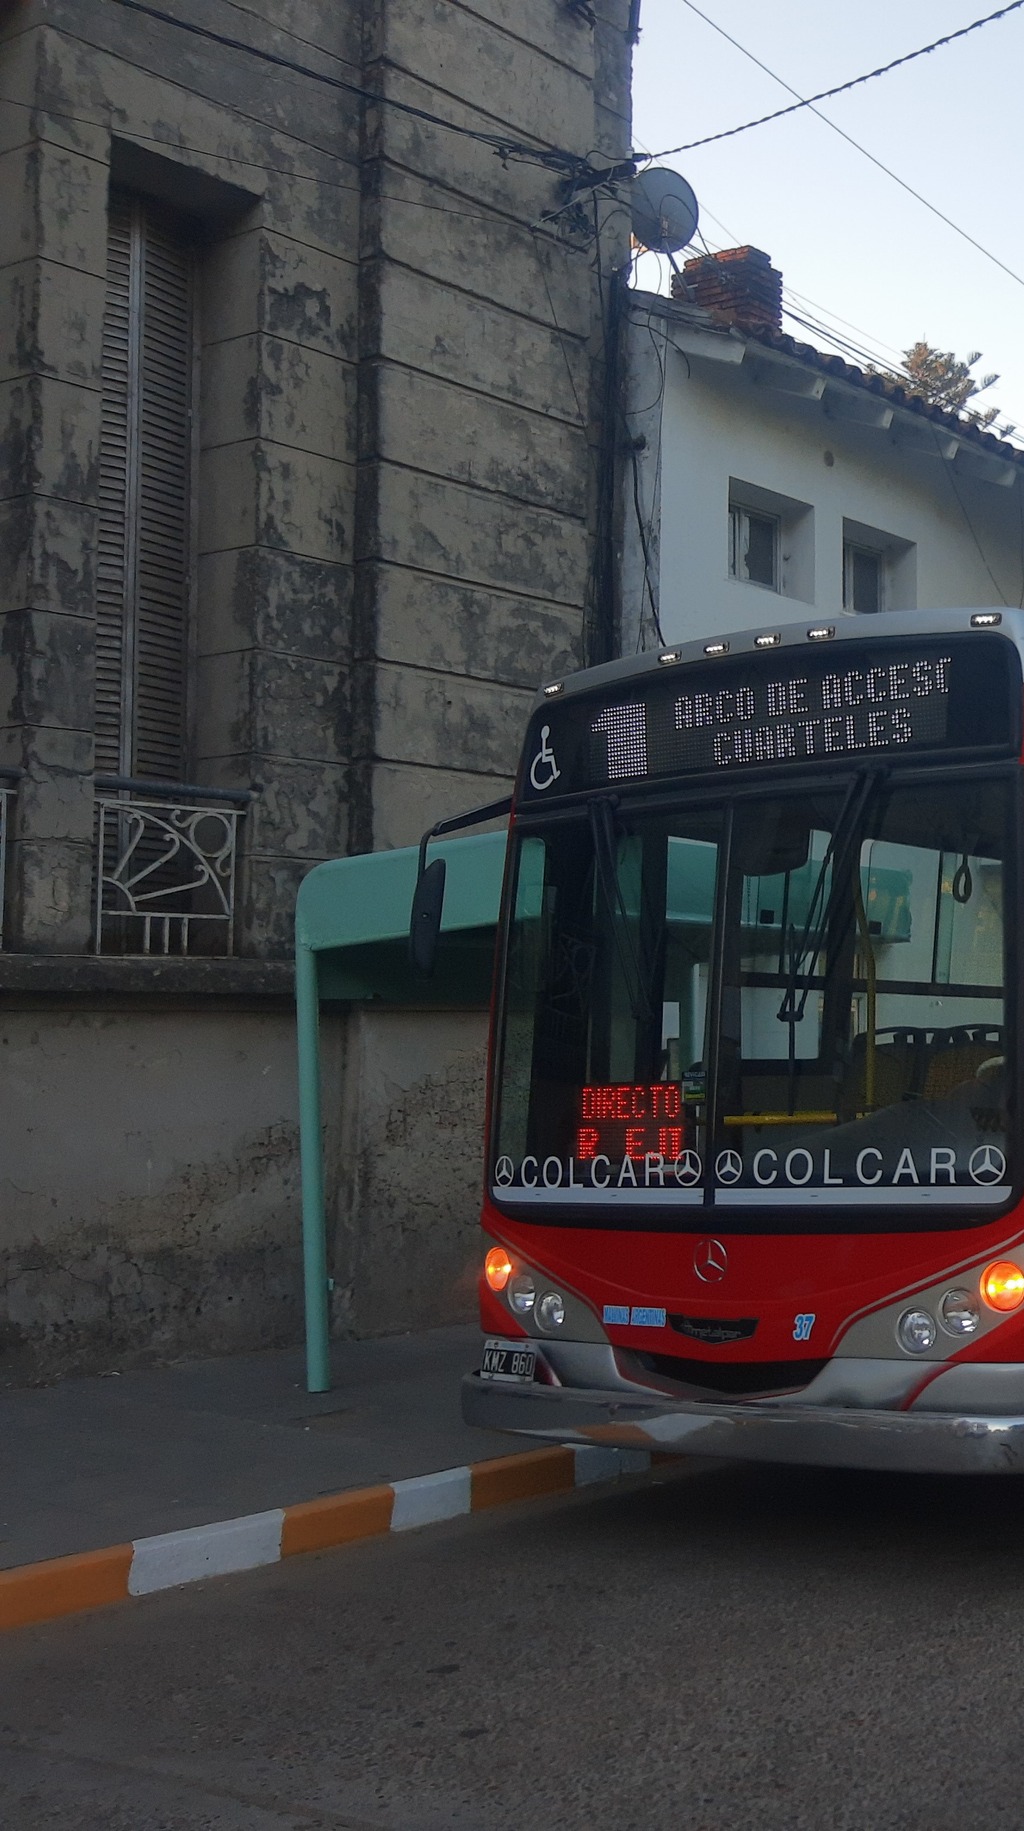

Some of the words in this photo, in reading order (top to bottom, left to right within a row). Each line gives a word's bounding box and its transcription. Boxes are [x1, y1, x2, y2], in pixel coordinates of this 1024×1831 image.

[674, 687, 755, 731] ARCO
[768, 677, 810, 715] DE
[590, 702, 648, 779] 1
[712, 706, 914, 766] CUARTELES
[582, 1085, 680, 1119] DIRECTO
[521, 1153, 666, 1188] COLCAR
[753, 1146, 958, 1186] COLCAR
[630, 1307, 667, 1328] ARGENTINAS
[792, 1313, 815, 1341] 37
[483, 1350, 508, 1373] KMZ
[511, 1353, 534, 1375] 860
